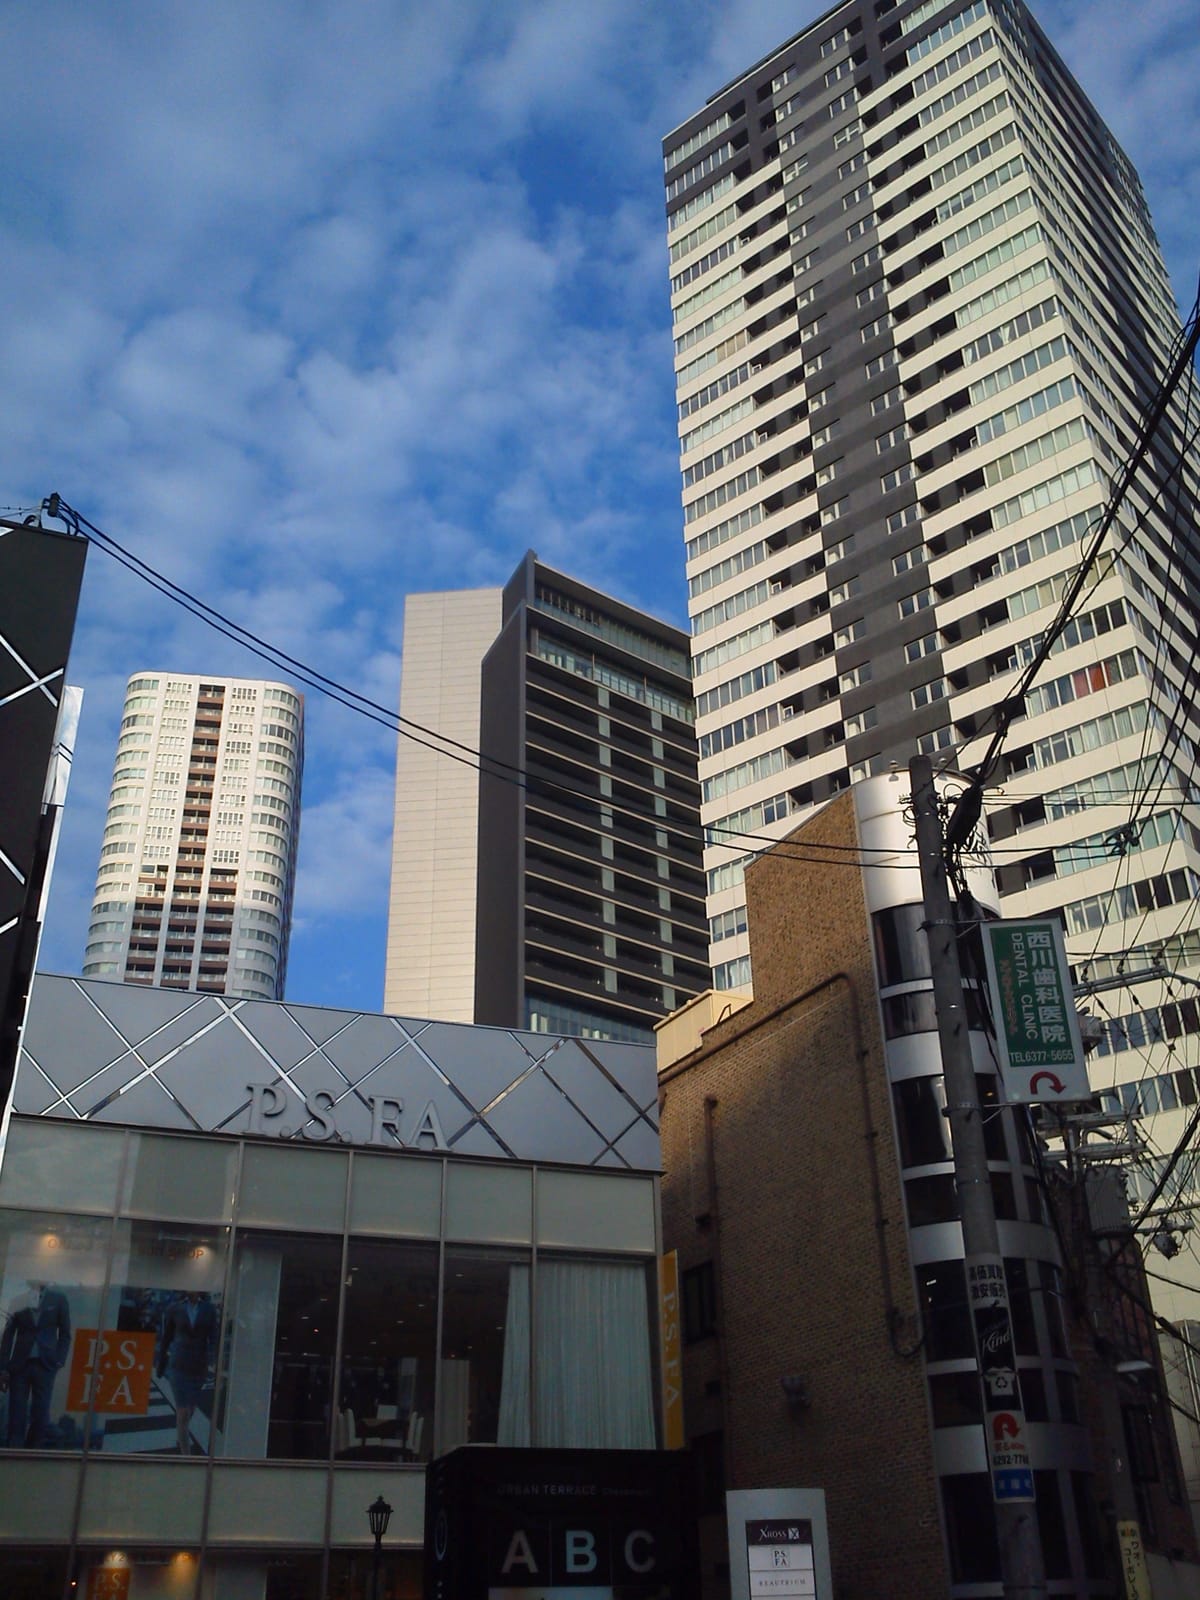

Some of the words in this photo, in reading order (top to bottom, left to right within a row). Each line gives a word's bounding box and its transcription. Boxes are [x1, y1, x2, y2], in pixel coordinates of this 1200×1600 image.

[1011, 932, 1029, 988] DENTAL
[1021, 994, 1039, 1040] CLINIC
[1026, 931, 1066, 1043] 西川歯科医院
[84, 1338, 145, 1371] P.S.
[543, 1483, 598, 1496] TERRACE
[501, 1530, 539, 1574] A
[565, 1530, 598, 1574] B
[624, 1530, 656, 1574] C
